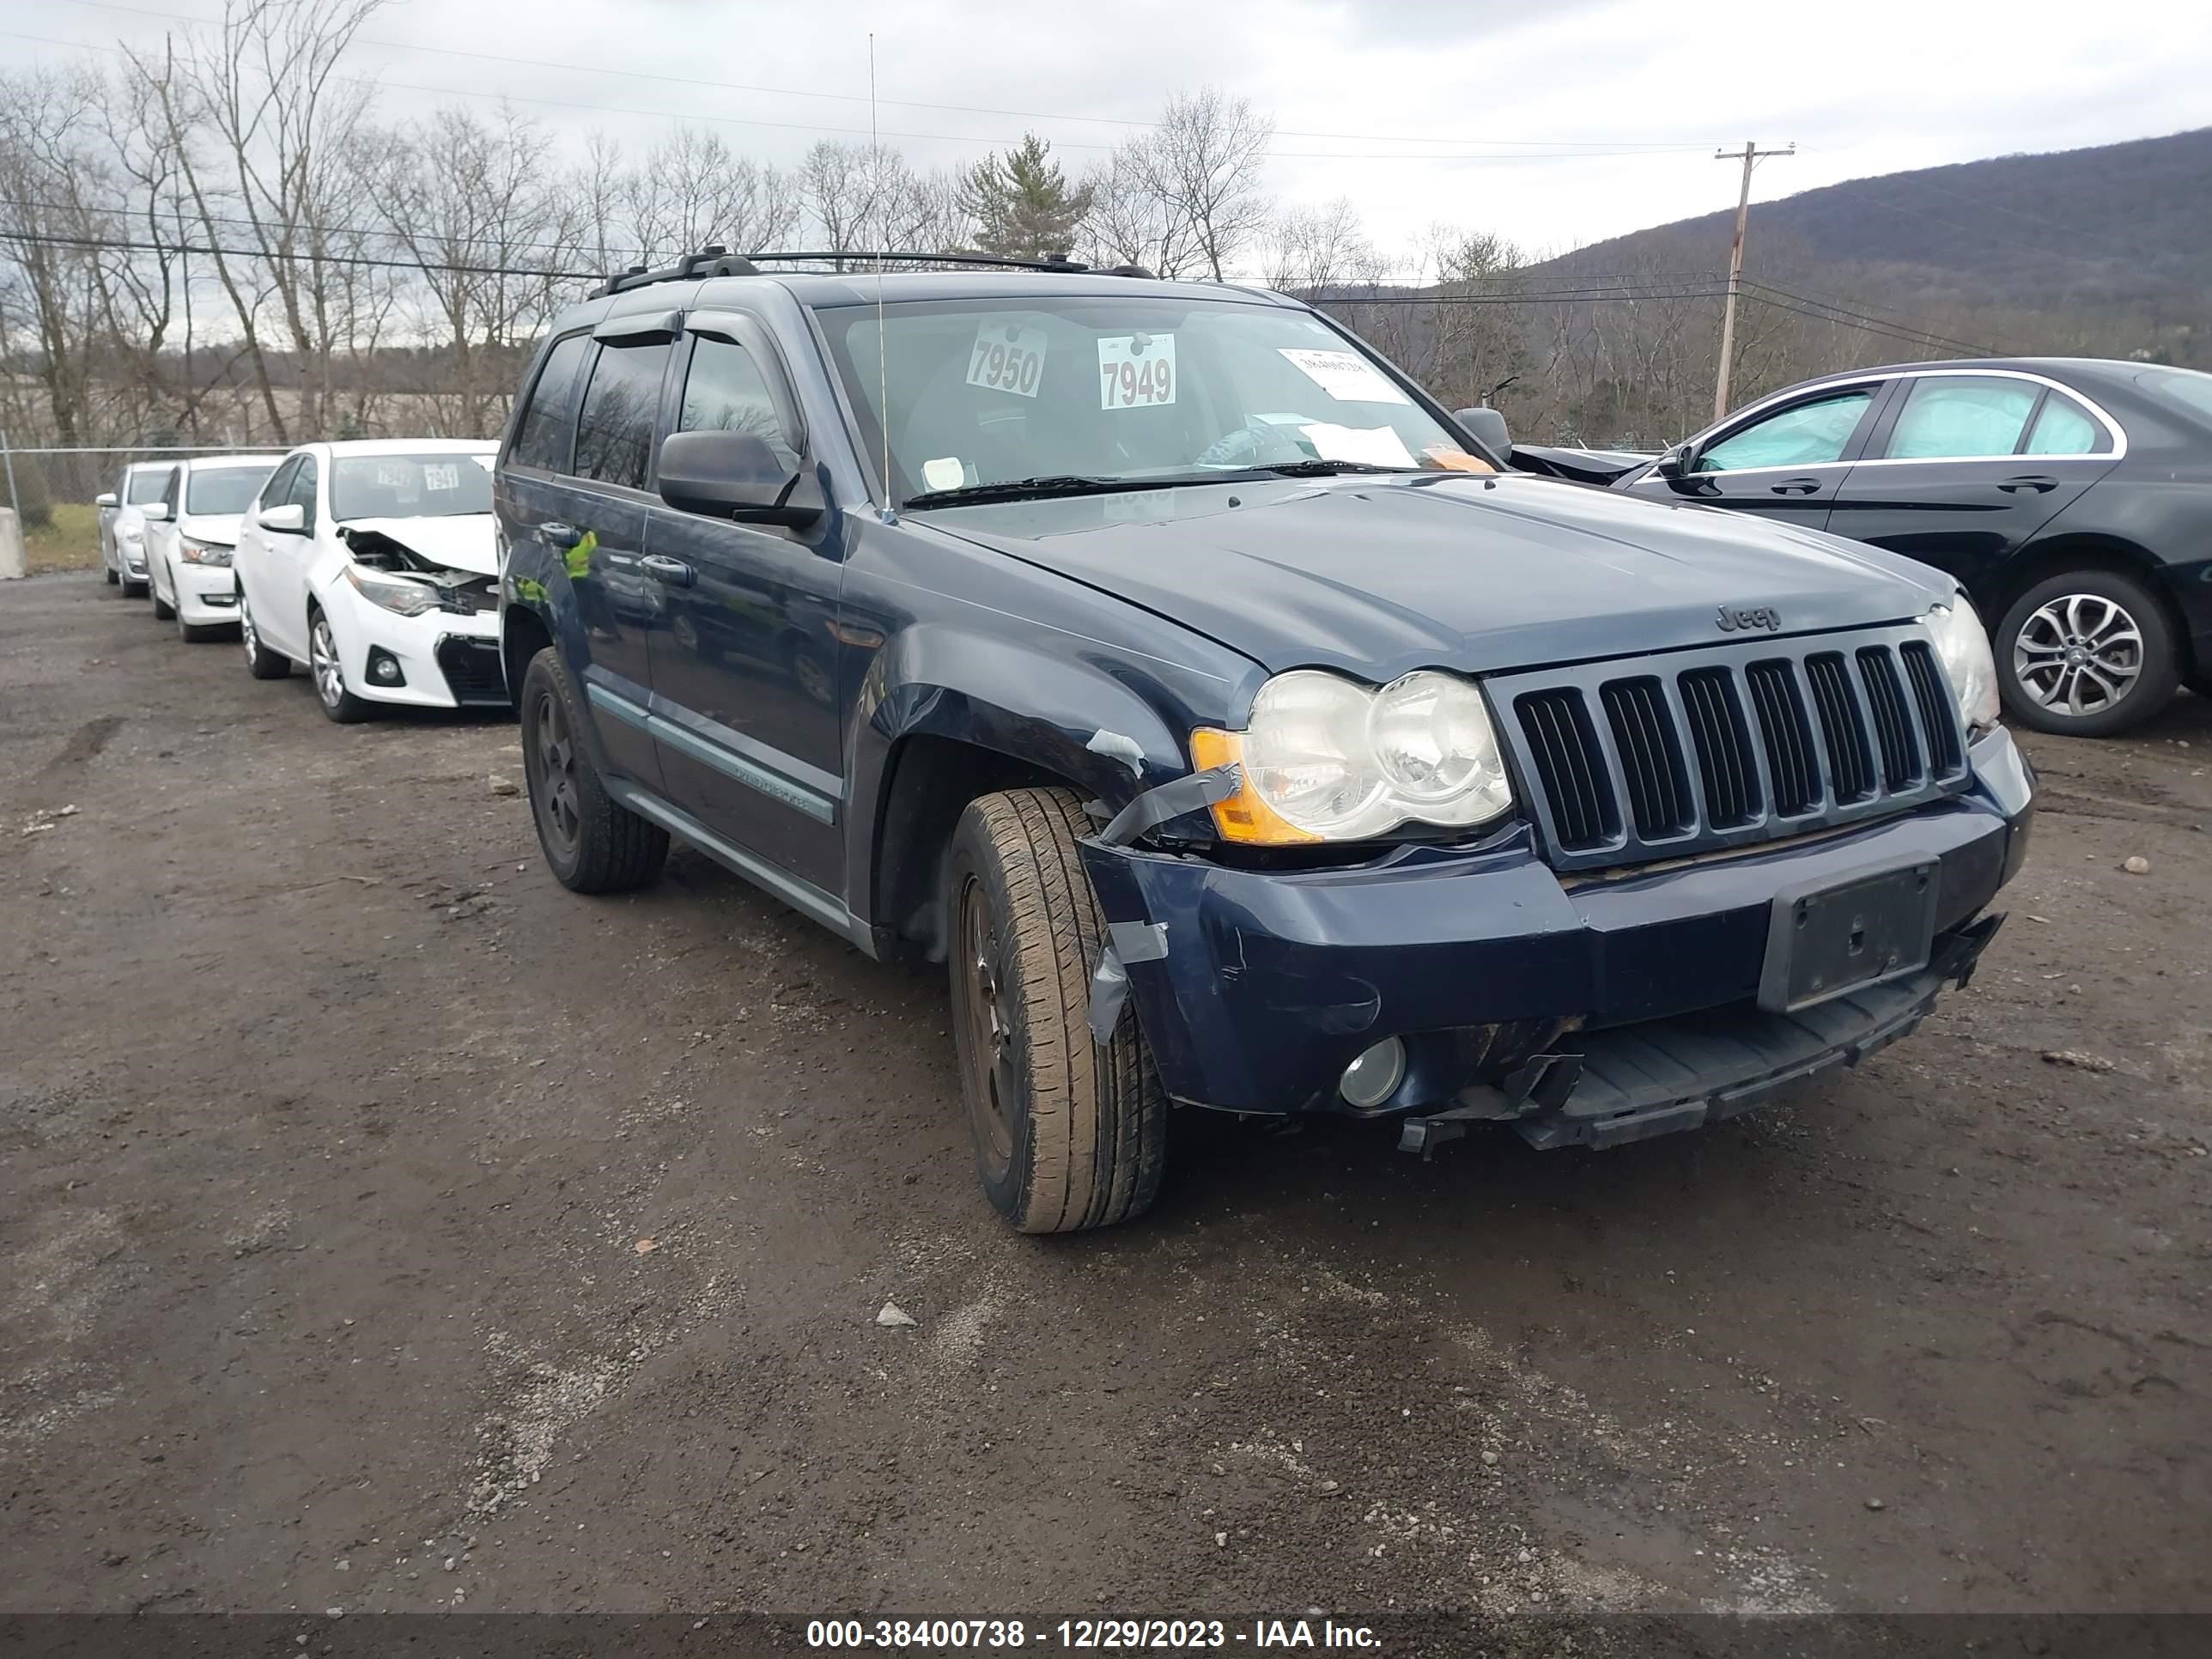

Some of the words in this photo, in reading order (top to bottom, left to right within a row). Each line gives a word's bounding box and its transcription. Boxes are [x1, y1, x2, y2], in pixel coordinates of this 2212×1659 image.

[972, 340, 1039, 393] 7950
[1103, 358, 1171, 407] 7949
[1716, 605, 1781, 632] Jeep
